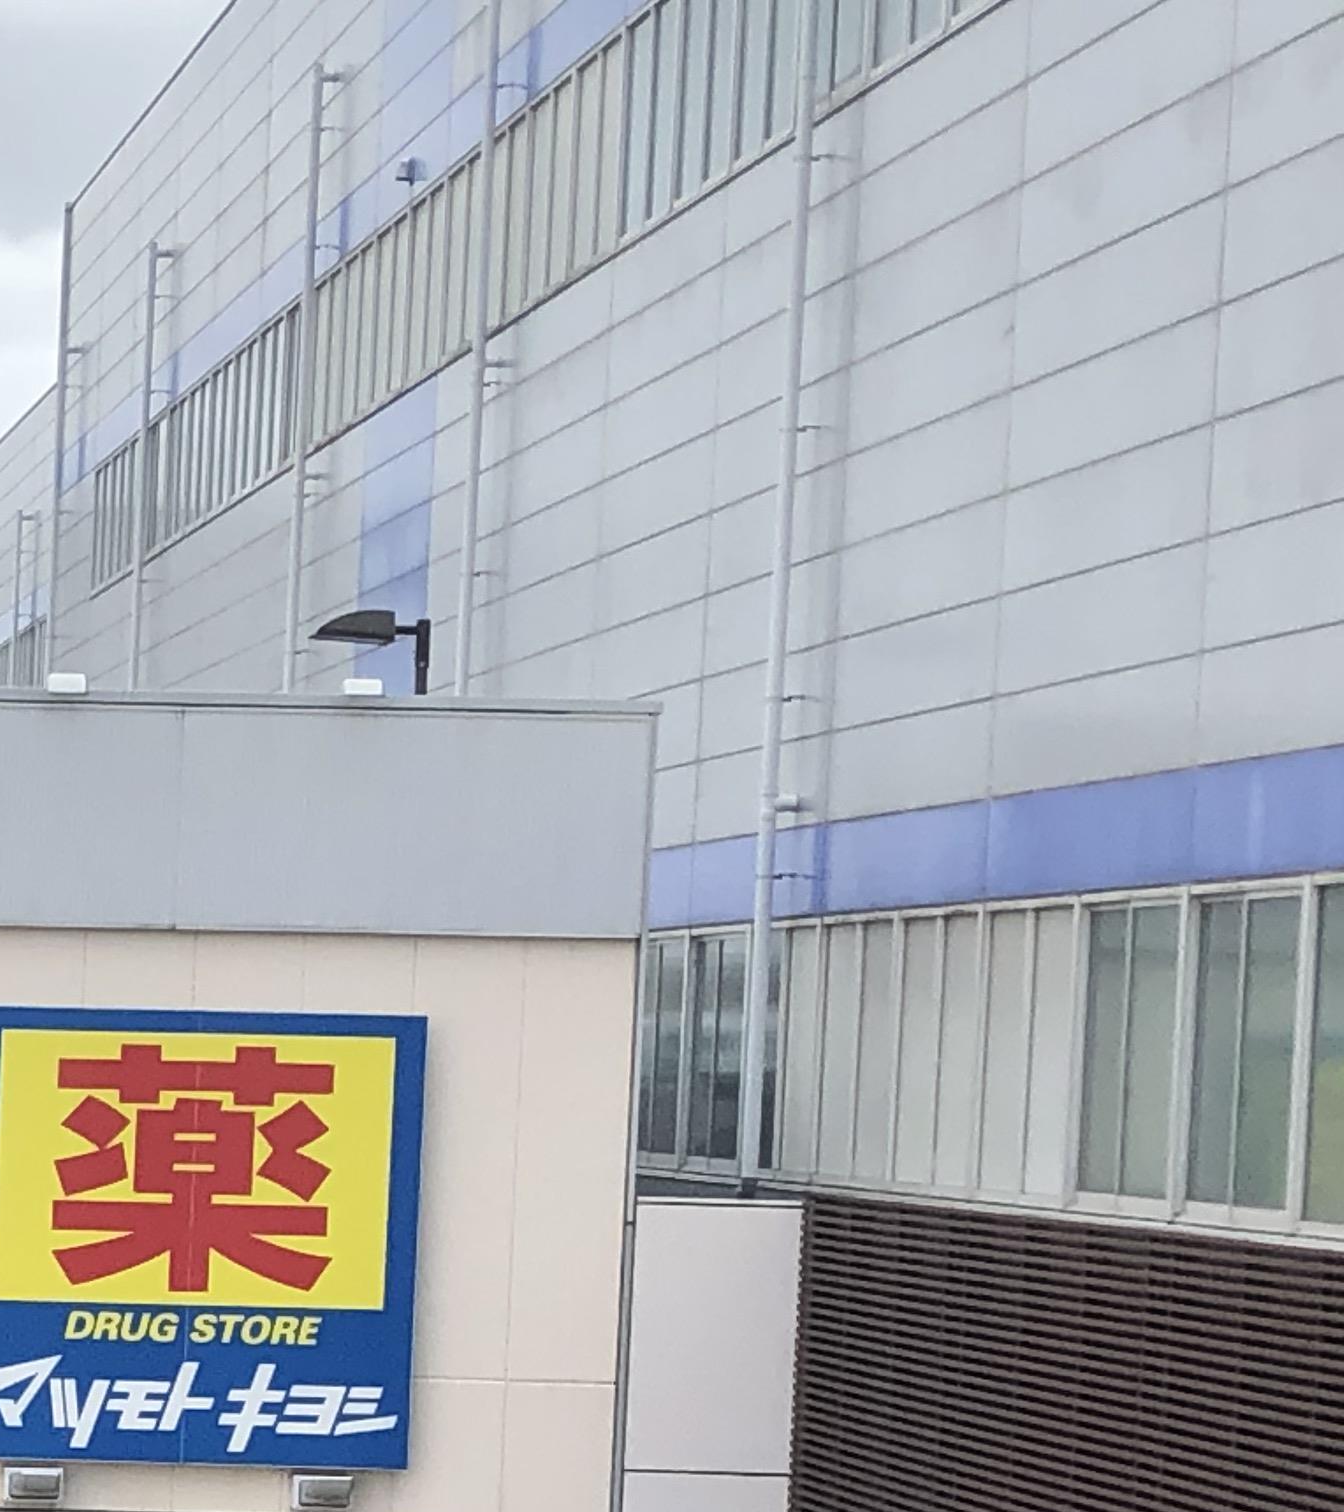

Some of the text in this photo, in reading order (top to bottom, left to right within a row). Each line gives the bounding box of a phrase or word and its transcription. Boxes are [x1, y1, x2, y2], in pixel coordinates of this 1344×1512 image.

[51, 1043, 336, 1293] 薬
[63, 1310, 323, 1347] DRUG STORE
